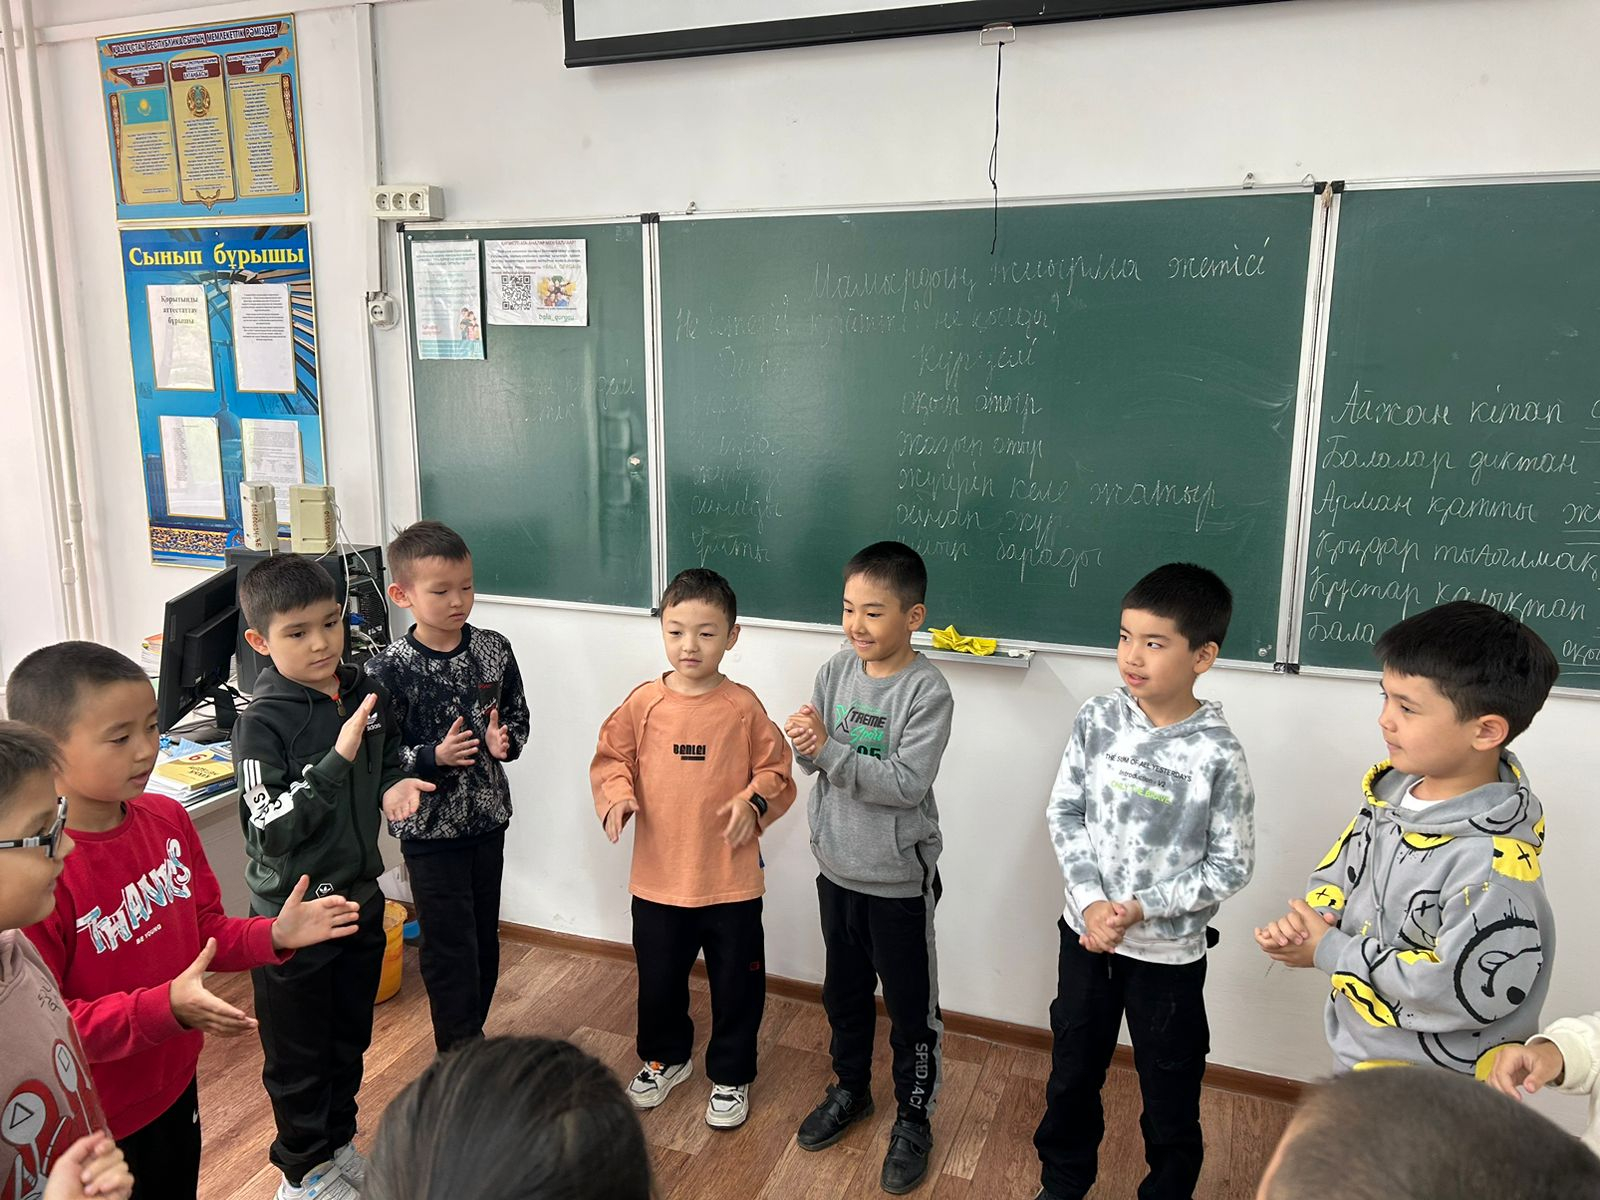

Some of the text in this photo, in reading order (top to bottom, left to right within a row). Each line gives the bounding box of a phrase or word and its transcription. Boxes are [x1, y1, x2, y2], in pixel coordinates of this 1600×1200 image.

[129, 243, 305, 269] Сынып бұрышы
[1469, 384, 1563, 424] кітап
[1322, 435, 1456, 489] Балалар
[1314, 479, 1412, 527] Арман
[1306, 612, 1376, 645] Бала
[76, 838, 191, 954] THANKS
